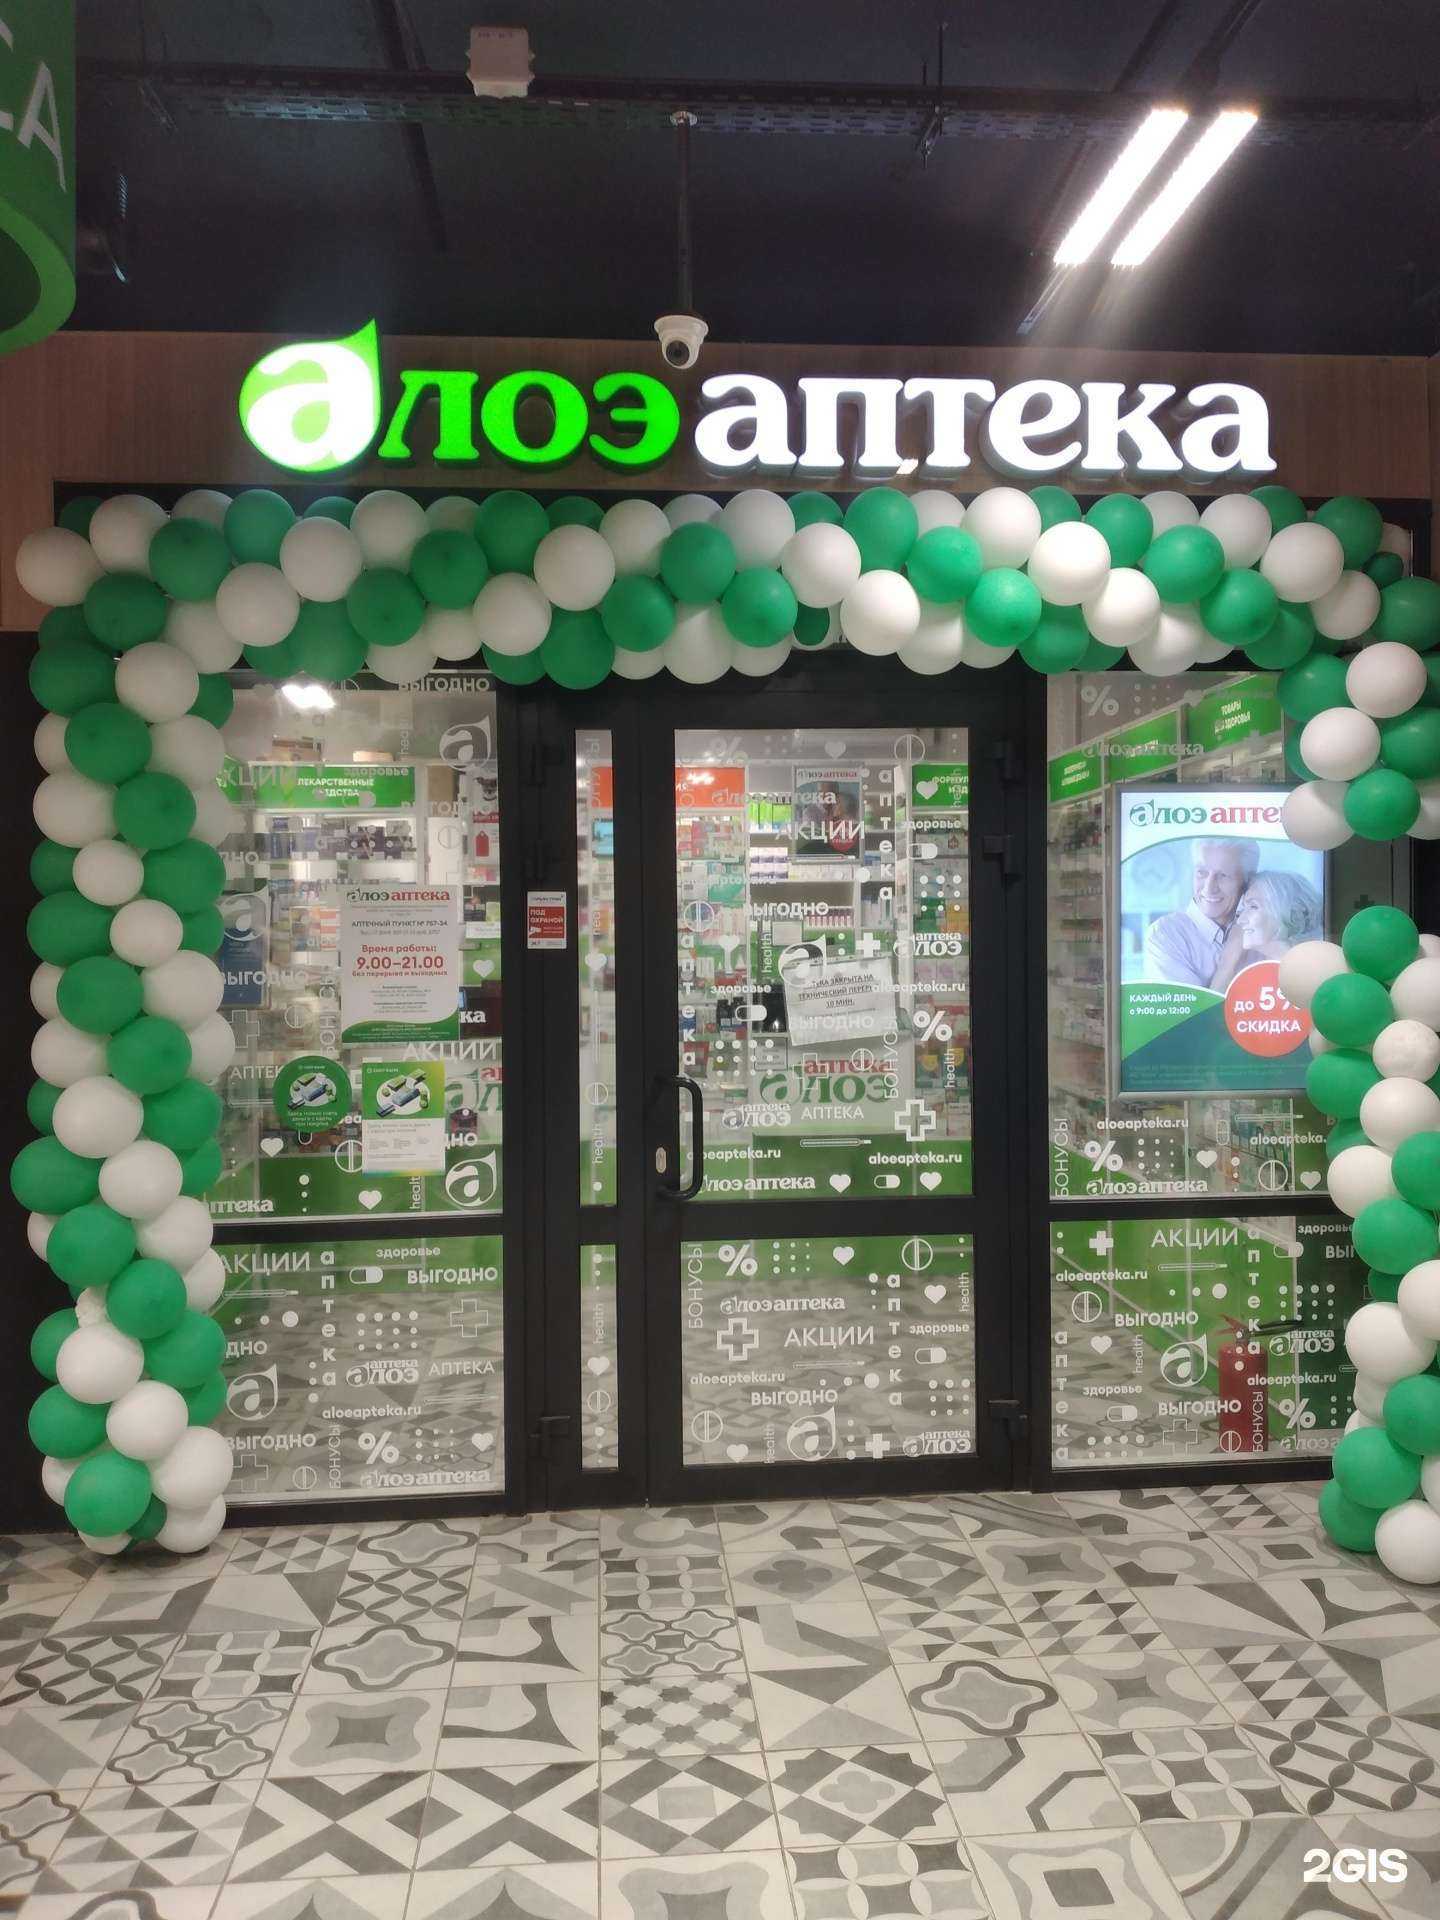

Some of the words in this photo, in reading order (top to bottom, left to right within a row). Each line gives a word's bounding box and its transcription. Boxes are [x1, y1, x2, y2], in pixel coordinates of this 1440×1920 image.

[694, 374, 1278, 475] аптека
[1209, 806, 1283, 825] апте
[1129, 993, 1172, 1003] КАЖДЫЙ
[1174, 993, 1197, 1003] ДЕНЬ
[1157, 1008, 1167, 1016] до
[1169, 1006, 1191, 1015] 12:00
[1234, 1000, 1254, 1013] до
[1237, 1020, 1301, 1034] СКИДКА
[1151, 1228, 1238, 1249] АКЦИИ
[784, 1326, 874, 1349] АКЦИИ
[429, 1361, 495, 1377] АПТЕКА
